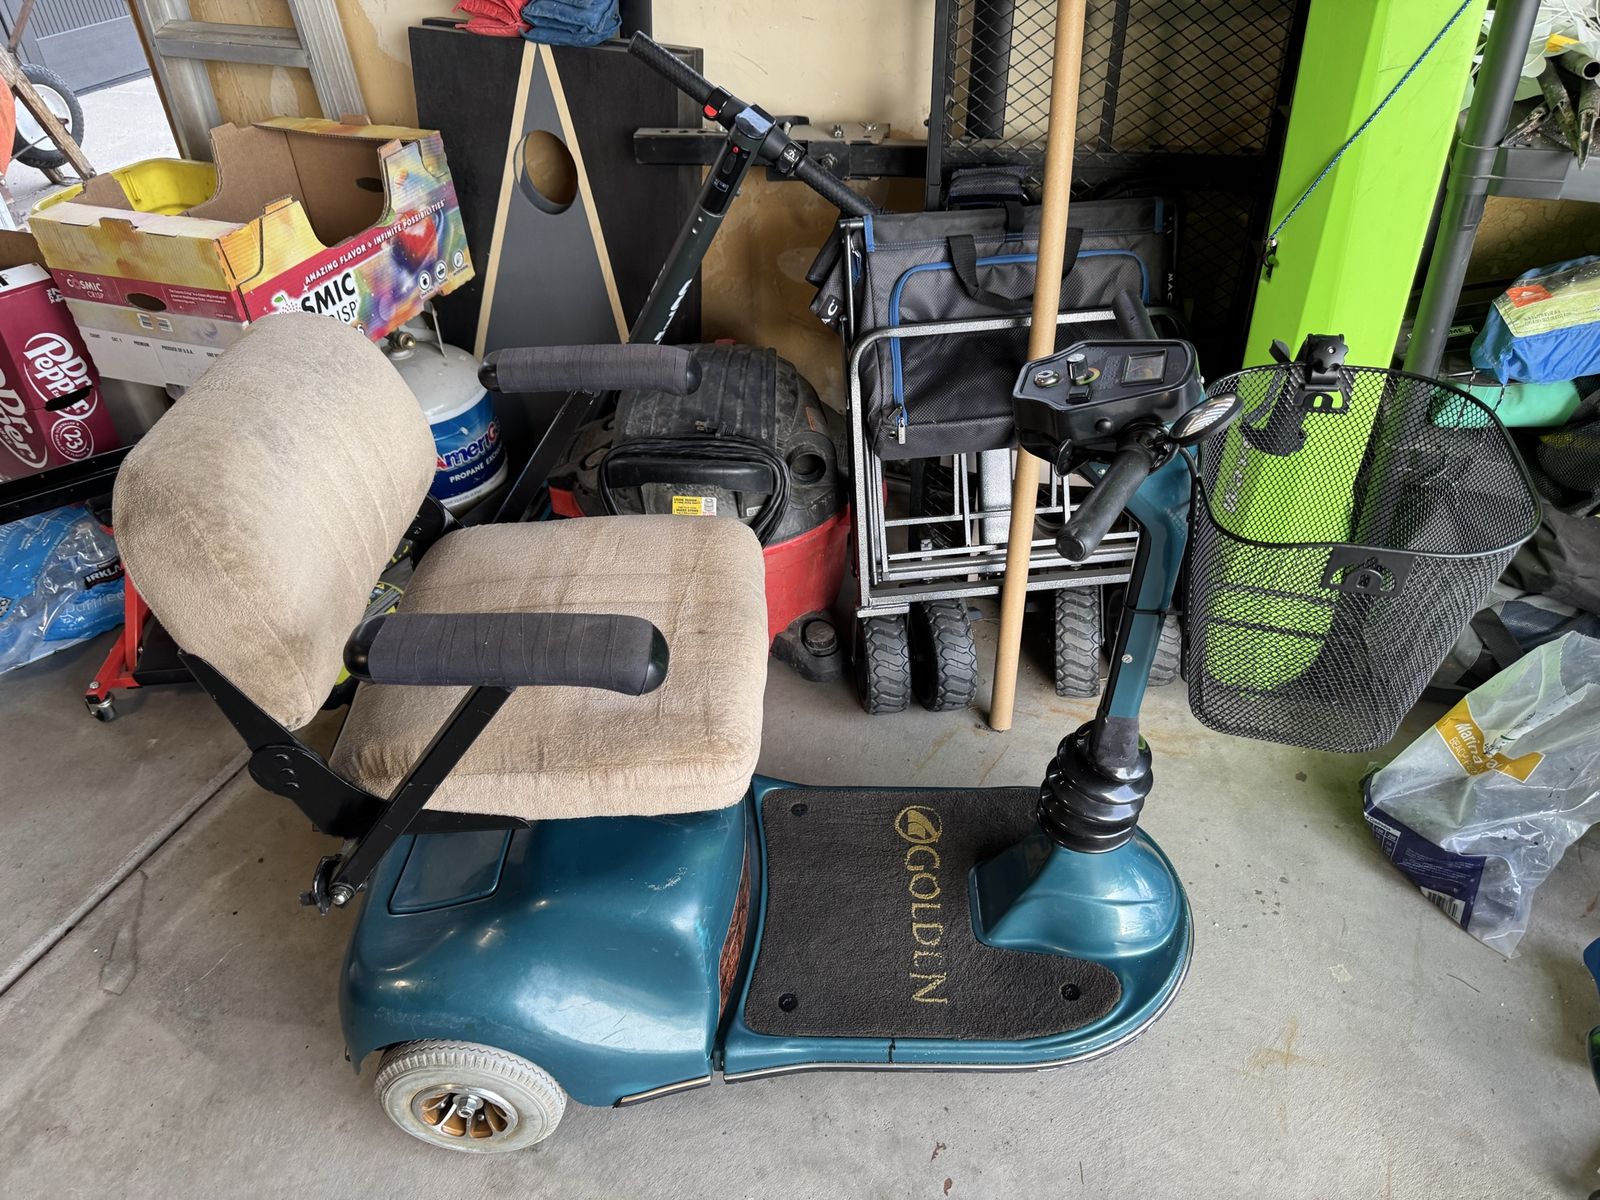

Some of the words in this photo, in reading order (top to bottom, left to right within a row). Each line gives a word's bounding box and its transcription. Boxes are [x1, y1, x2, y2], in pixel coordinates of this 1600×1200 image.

[304, 262, 339, 285] AMAZING
[340, 243, 367, 265] FLAVOR
[373, 224, 402, 246] INFINITE
[402, 199, 446, 229] POSSIBILITIES
[66, 278, 103, 292] COSMIC
[87, 290, 104, 299] CRISP
[301, 271, 356, 315] SMIC
[23, 333, 90, 415] Peppr
[58, 355, 93, 388] Dr
[62, 429, 84, 449] 23
[449, 462, 485, 483] PROPANE
[85, 564, 122, 582] IRKLA
[1455, 723, 1483, 764] Marina
[904, 845, 949, 1005] GOLDEN
